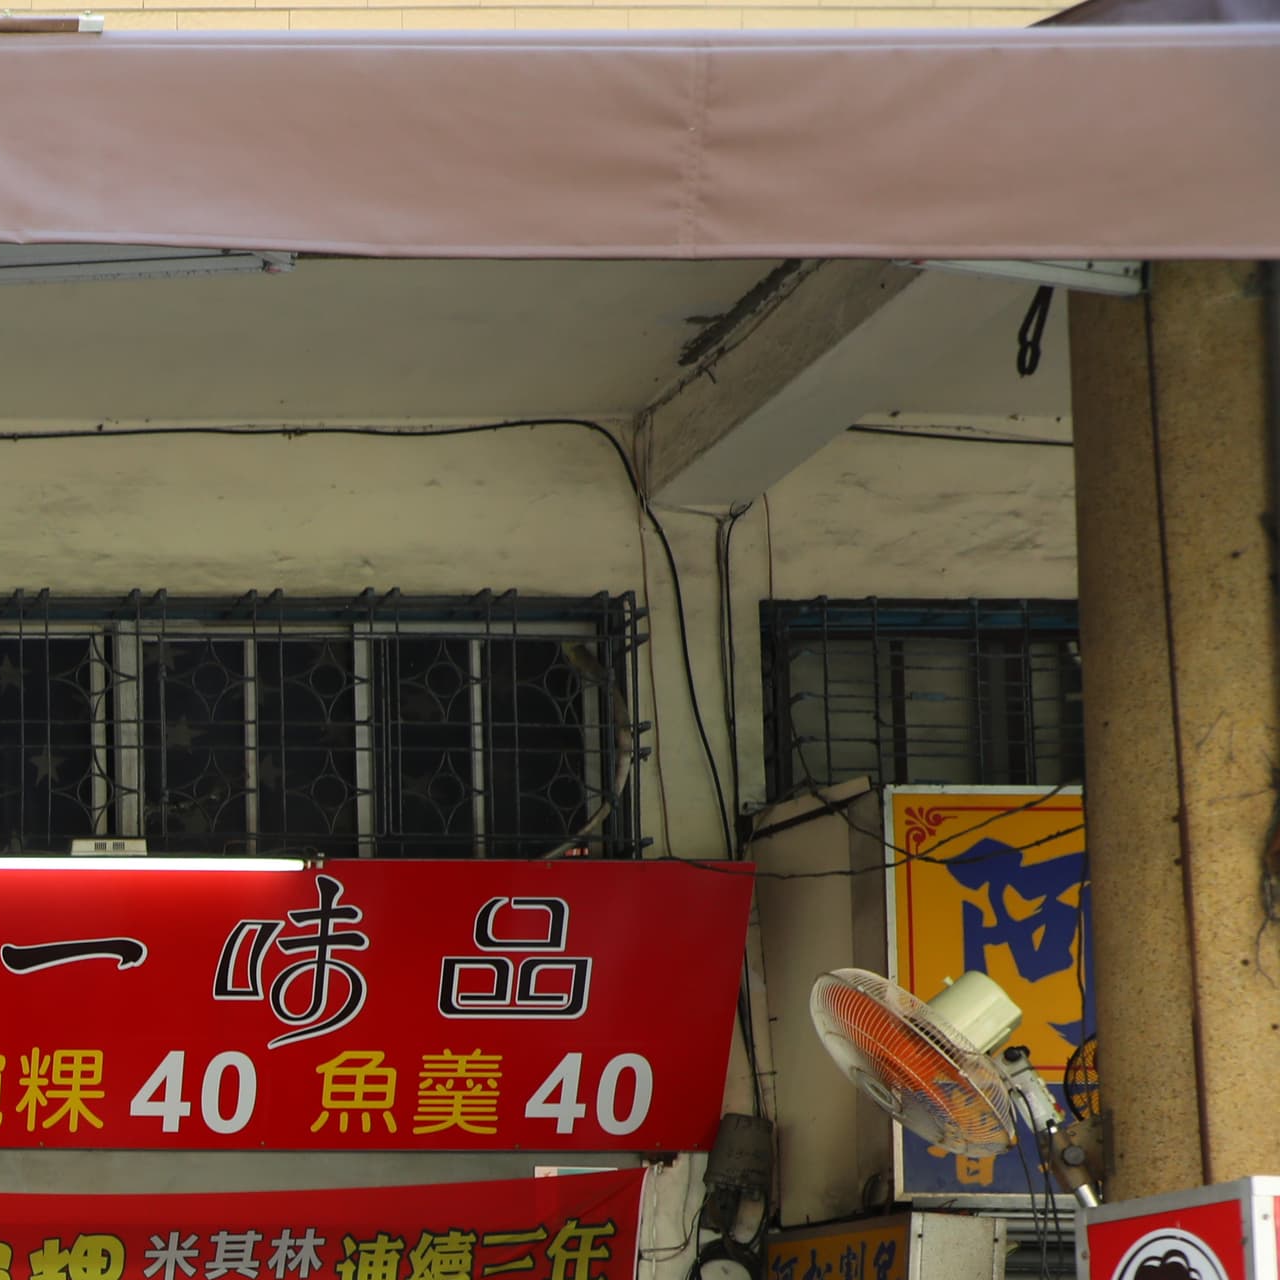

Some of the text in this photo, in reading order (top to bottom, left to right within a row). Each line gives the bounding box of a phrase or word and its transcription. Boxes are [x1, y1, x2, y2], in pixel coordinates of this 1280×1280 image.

[0, 873, 596, 1052] 一味品
[129, 1049, 259, 1136] 40
[310, 1048, 505, 1137] 魚羹
[524, 1052, 654, 1137] 40
